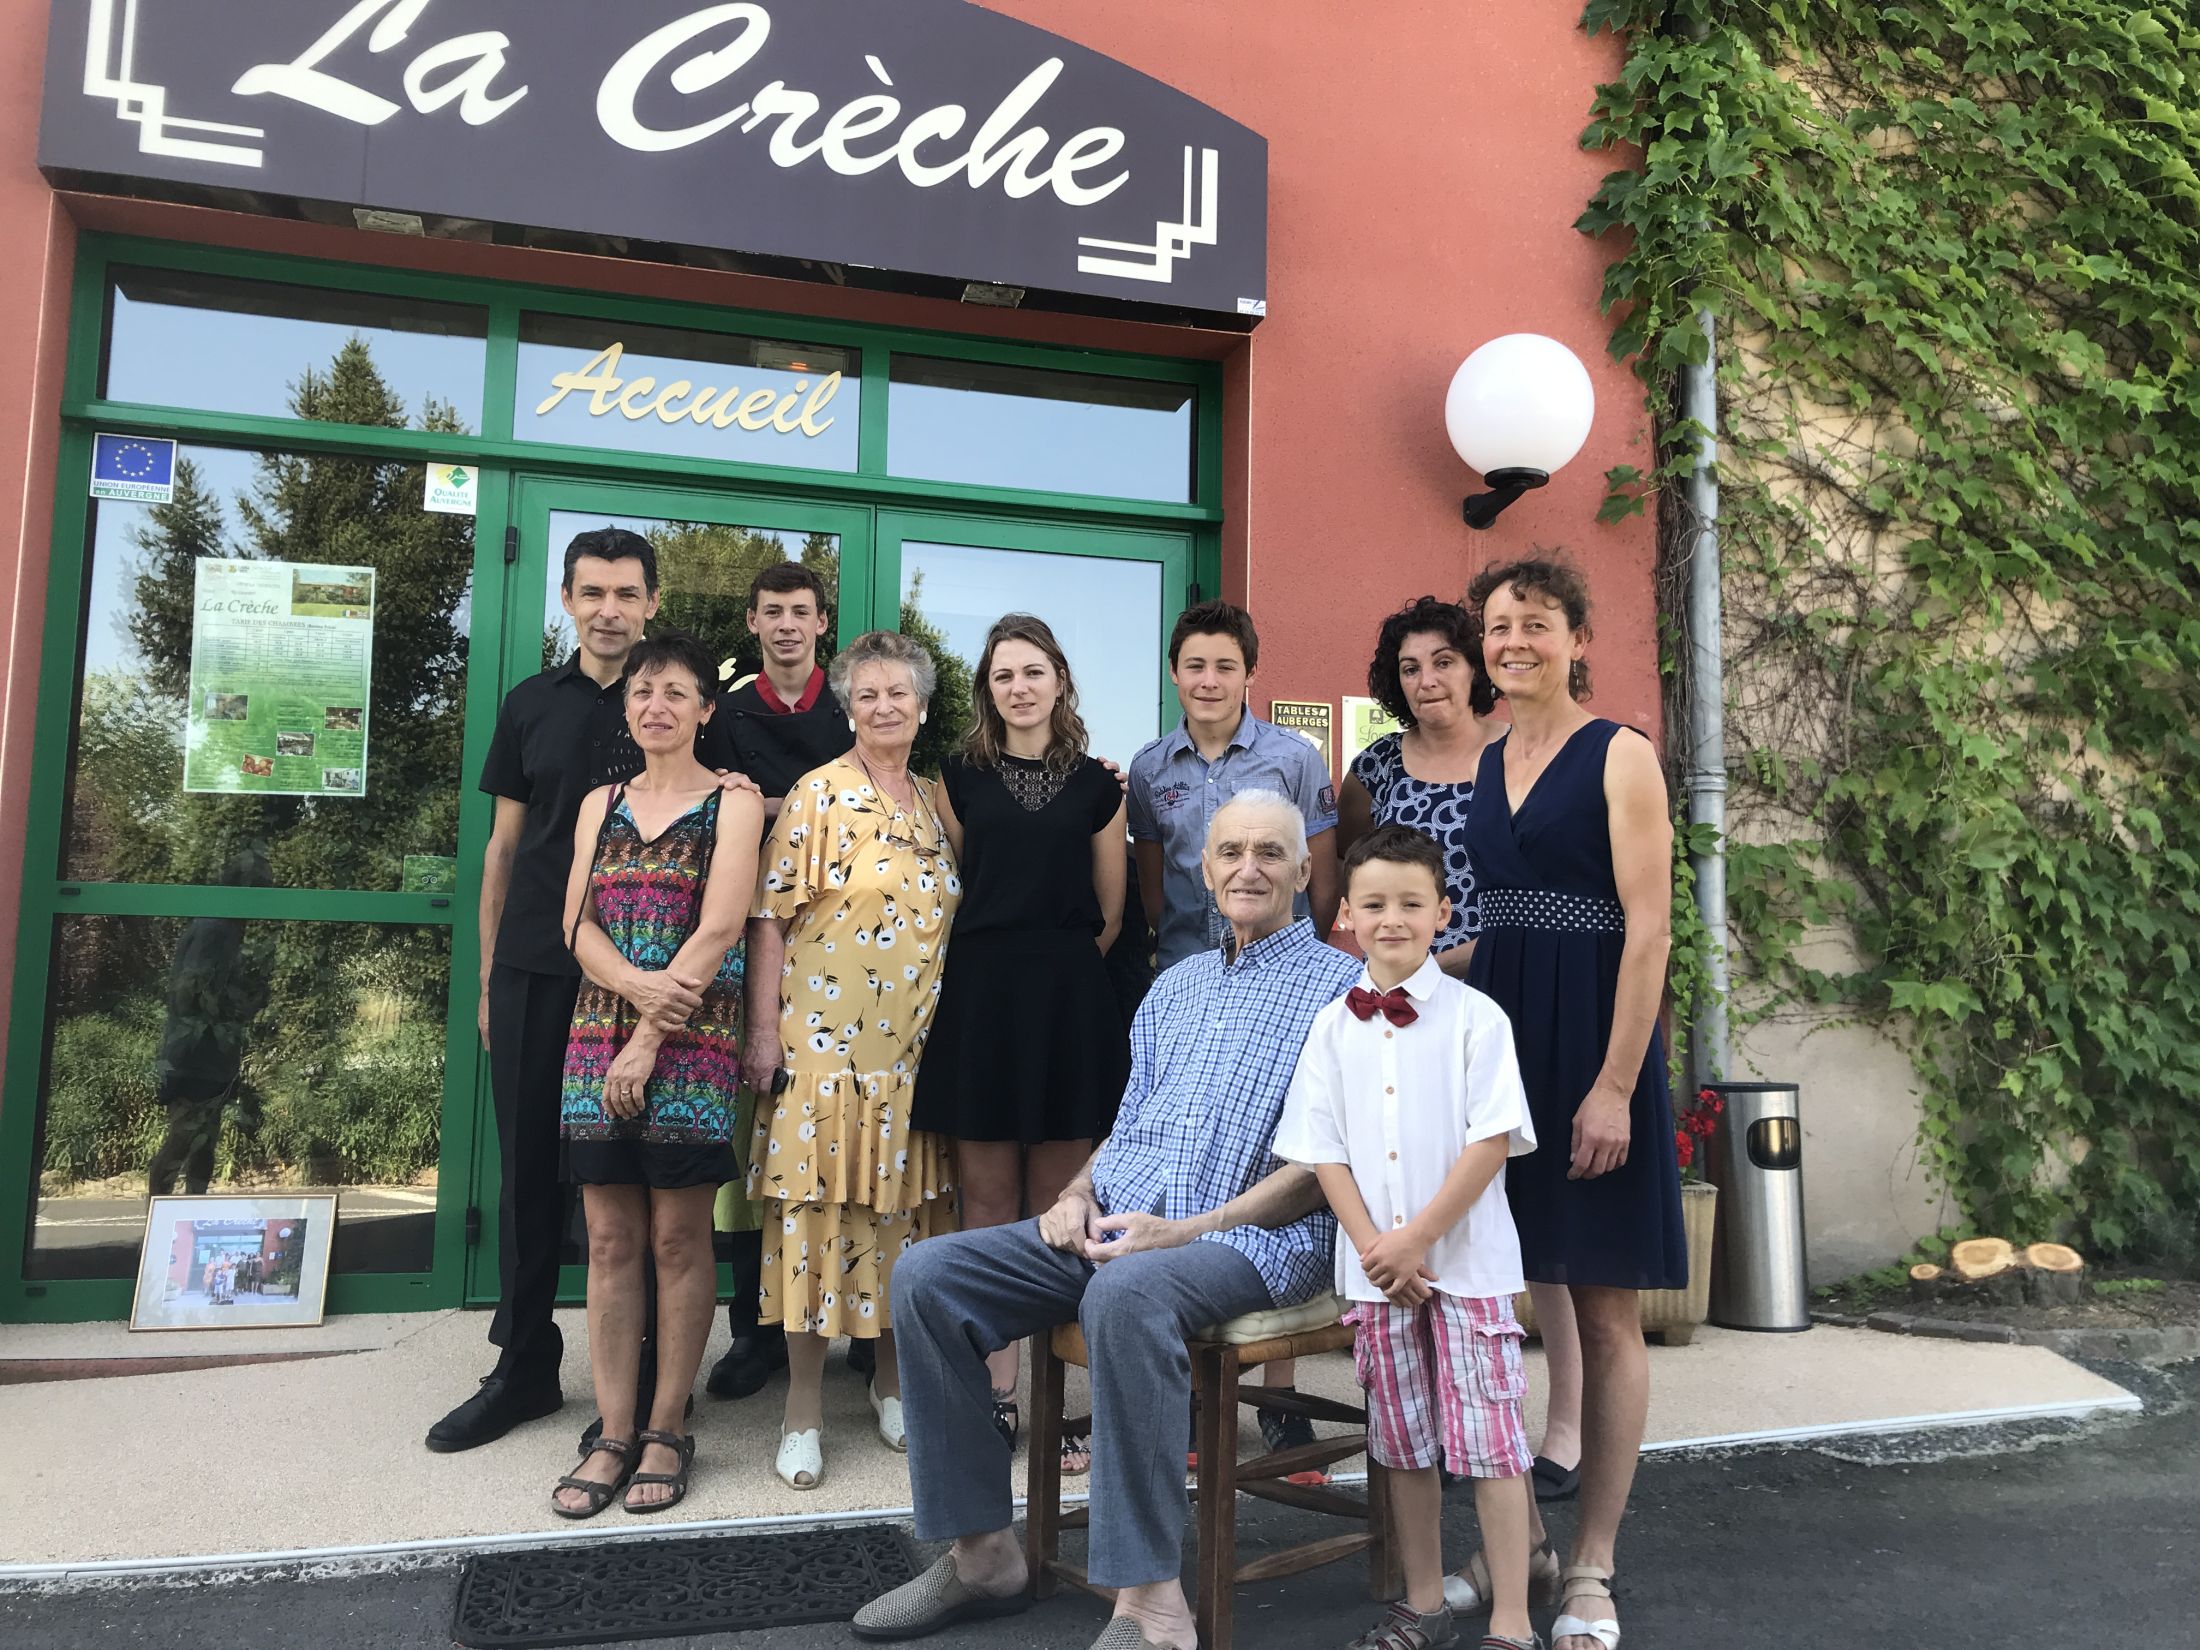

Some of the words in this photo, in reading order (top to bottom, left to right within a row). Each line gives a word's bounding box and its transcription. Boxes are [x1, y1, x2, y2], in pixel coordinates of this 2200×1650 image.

[231, 0, 532, 126] La
[596, 2, 1130, 206] Crèche
[536, 341, 842, 436] Accueil
[108, 489, 168, 501] AUVERGNE
[200, 598, 224, 612] La
[227, 600, 279, 615] Crèche
[1276, 705, 1319, 716] TABLES
[1276, 716, 1329, 727] AUBERGES
